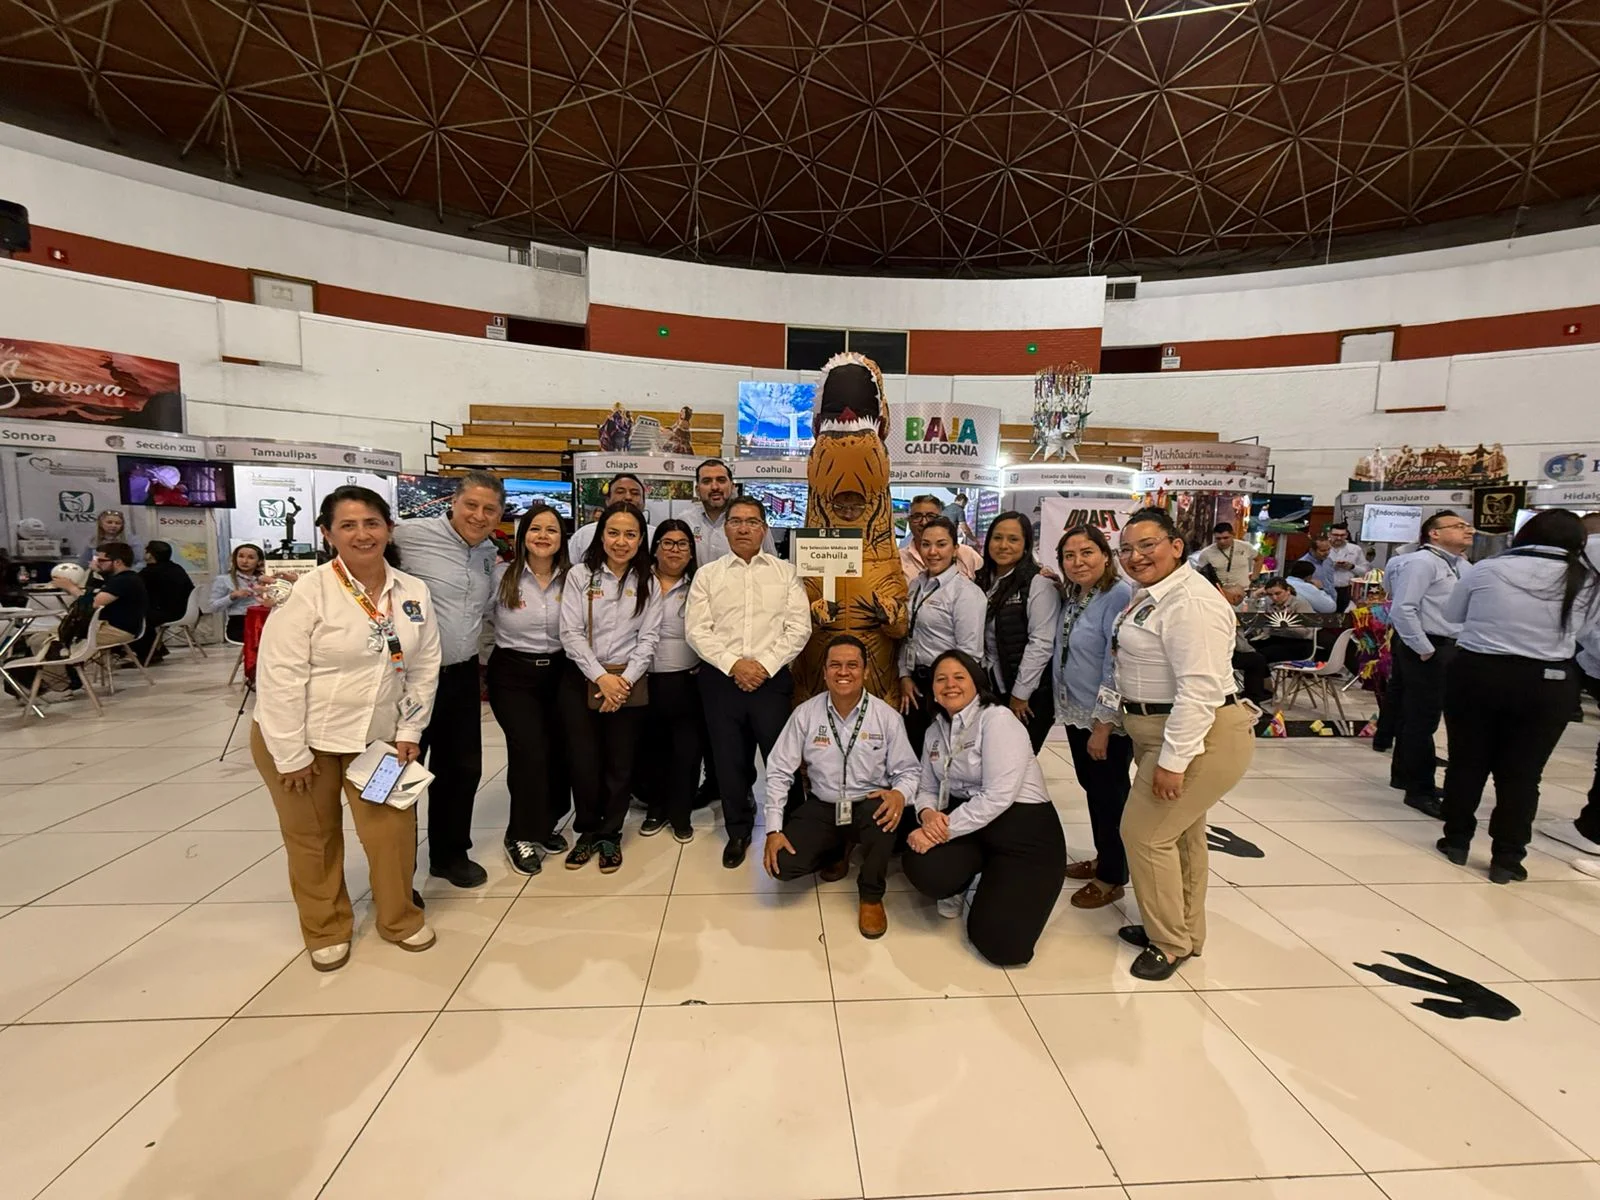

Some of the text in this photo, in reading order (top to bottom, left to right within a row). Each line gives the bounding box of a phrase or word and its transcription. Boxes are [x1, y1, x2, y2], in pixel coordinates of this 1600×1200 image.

[0, 360, 126, 409] Sonora
[2, 429, 56, 442] Sonora
[905, 416, 978, 444] BAJA
[136, 441, 196, 453] Sección XIII
[905, 443, 978, 456] CALIFORNIA
[251, 447, 317, 460] Tamaulipas
[606, 461, 638, 470] Chiapas
[756, 465, 792, 474] Coahuila
[890, 471, 951, 480] Baja California
[1175, 477, 1223, 486] Michoacán
[1374, 493, 1430, 503] Guanajuato
[60, 513, 97, 522] IMSS
[160, 517, 204, 525] SONORA
[1064, 509, 1120, 531] DRAFT
